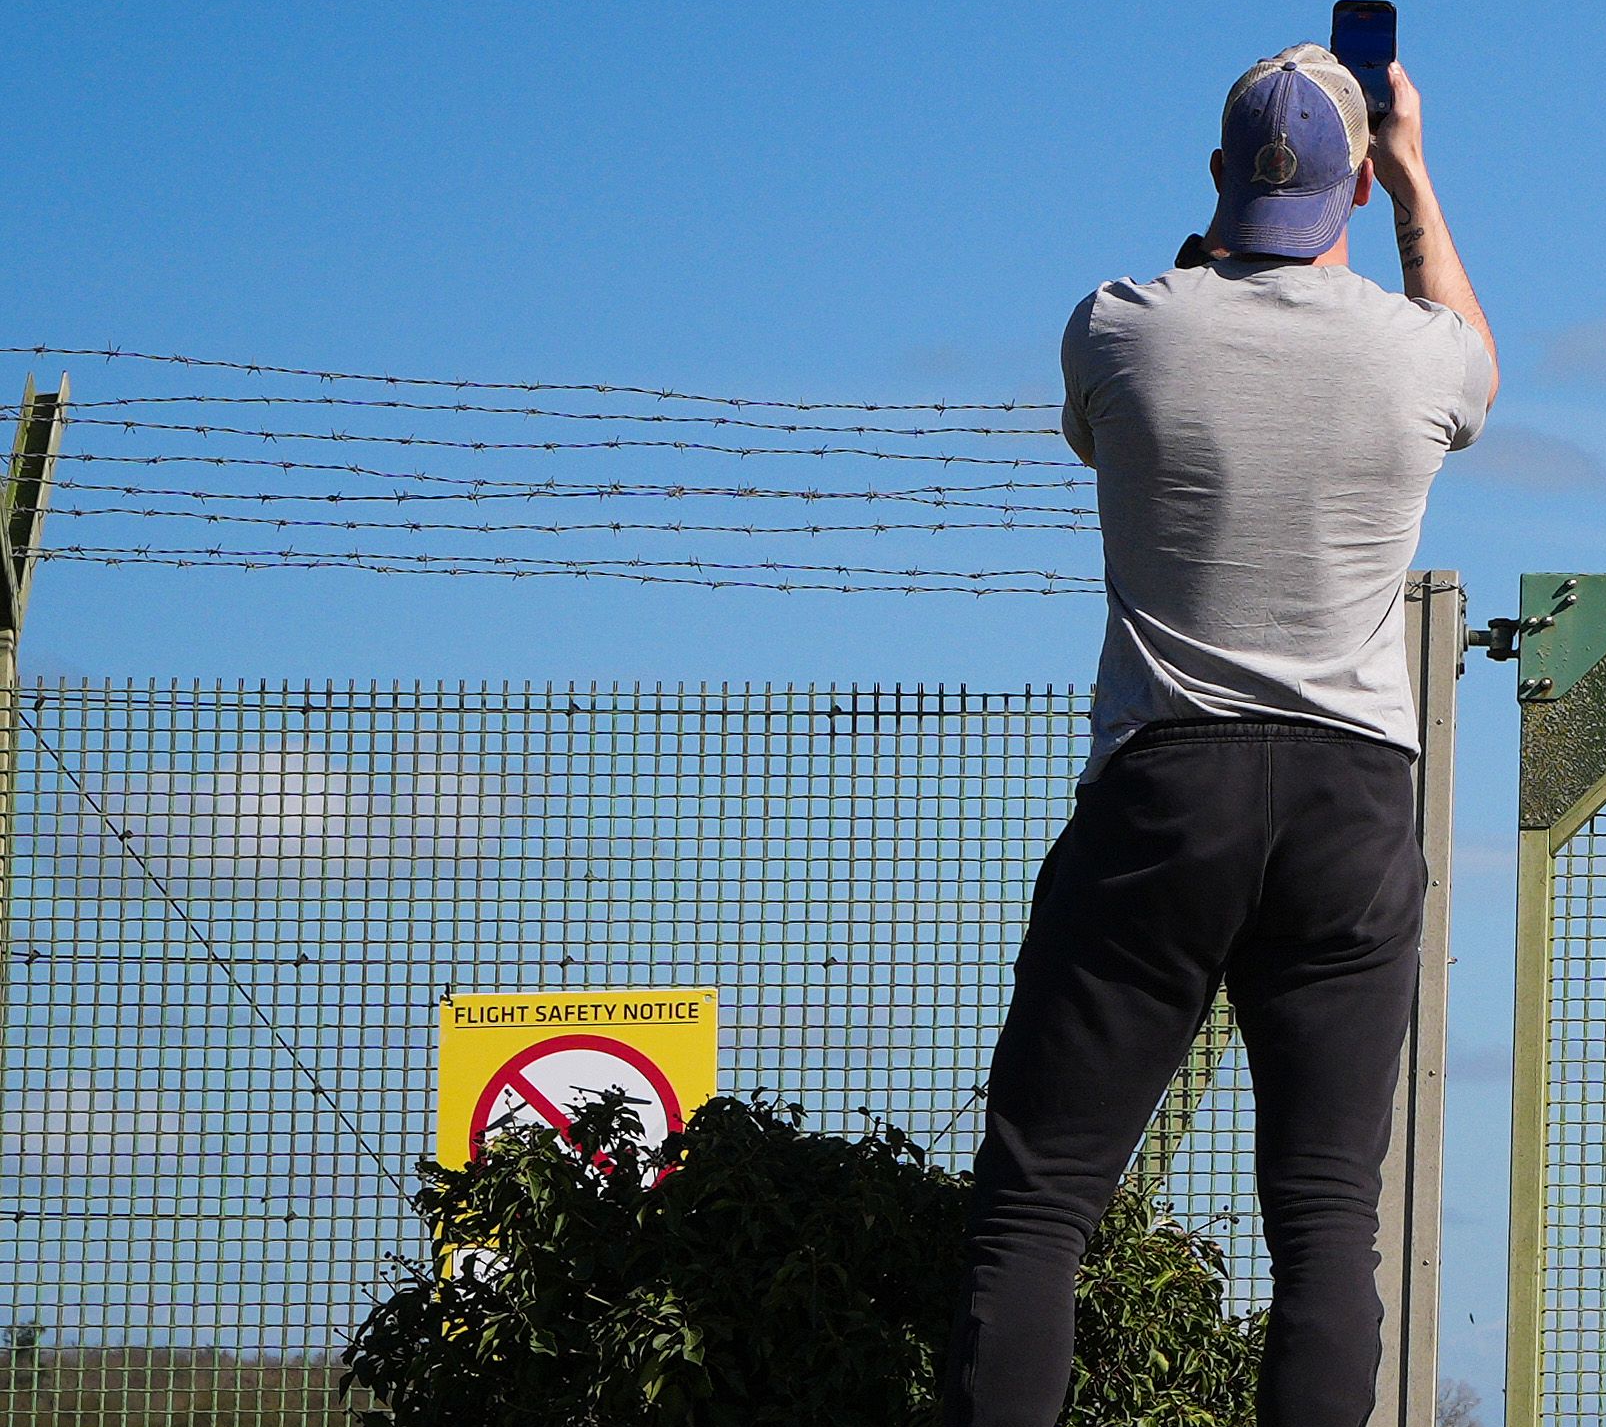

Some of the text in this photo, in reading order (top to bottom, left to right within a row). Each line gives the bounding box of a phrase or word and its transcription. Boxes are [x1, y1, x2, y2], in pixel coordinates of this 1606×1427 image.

[454, 1002, 699, 1024] FLIGHT SAFETY NOTICE
